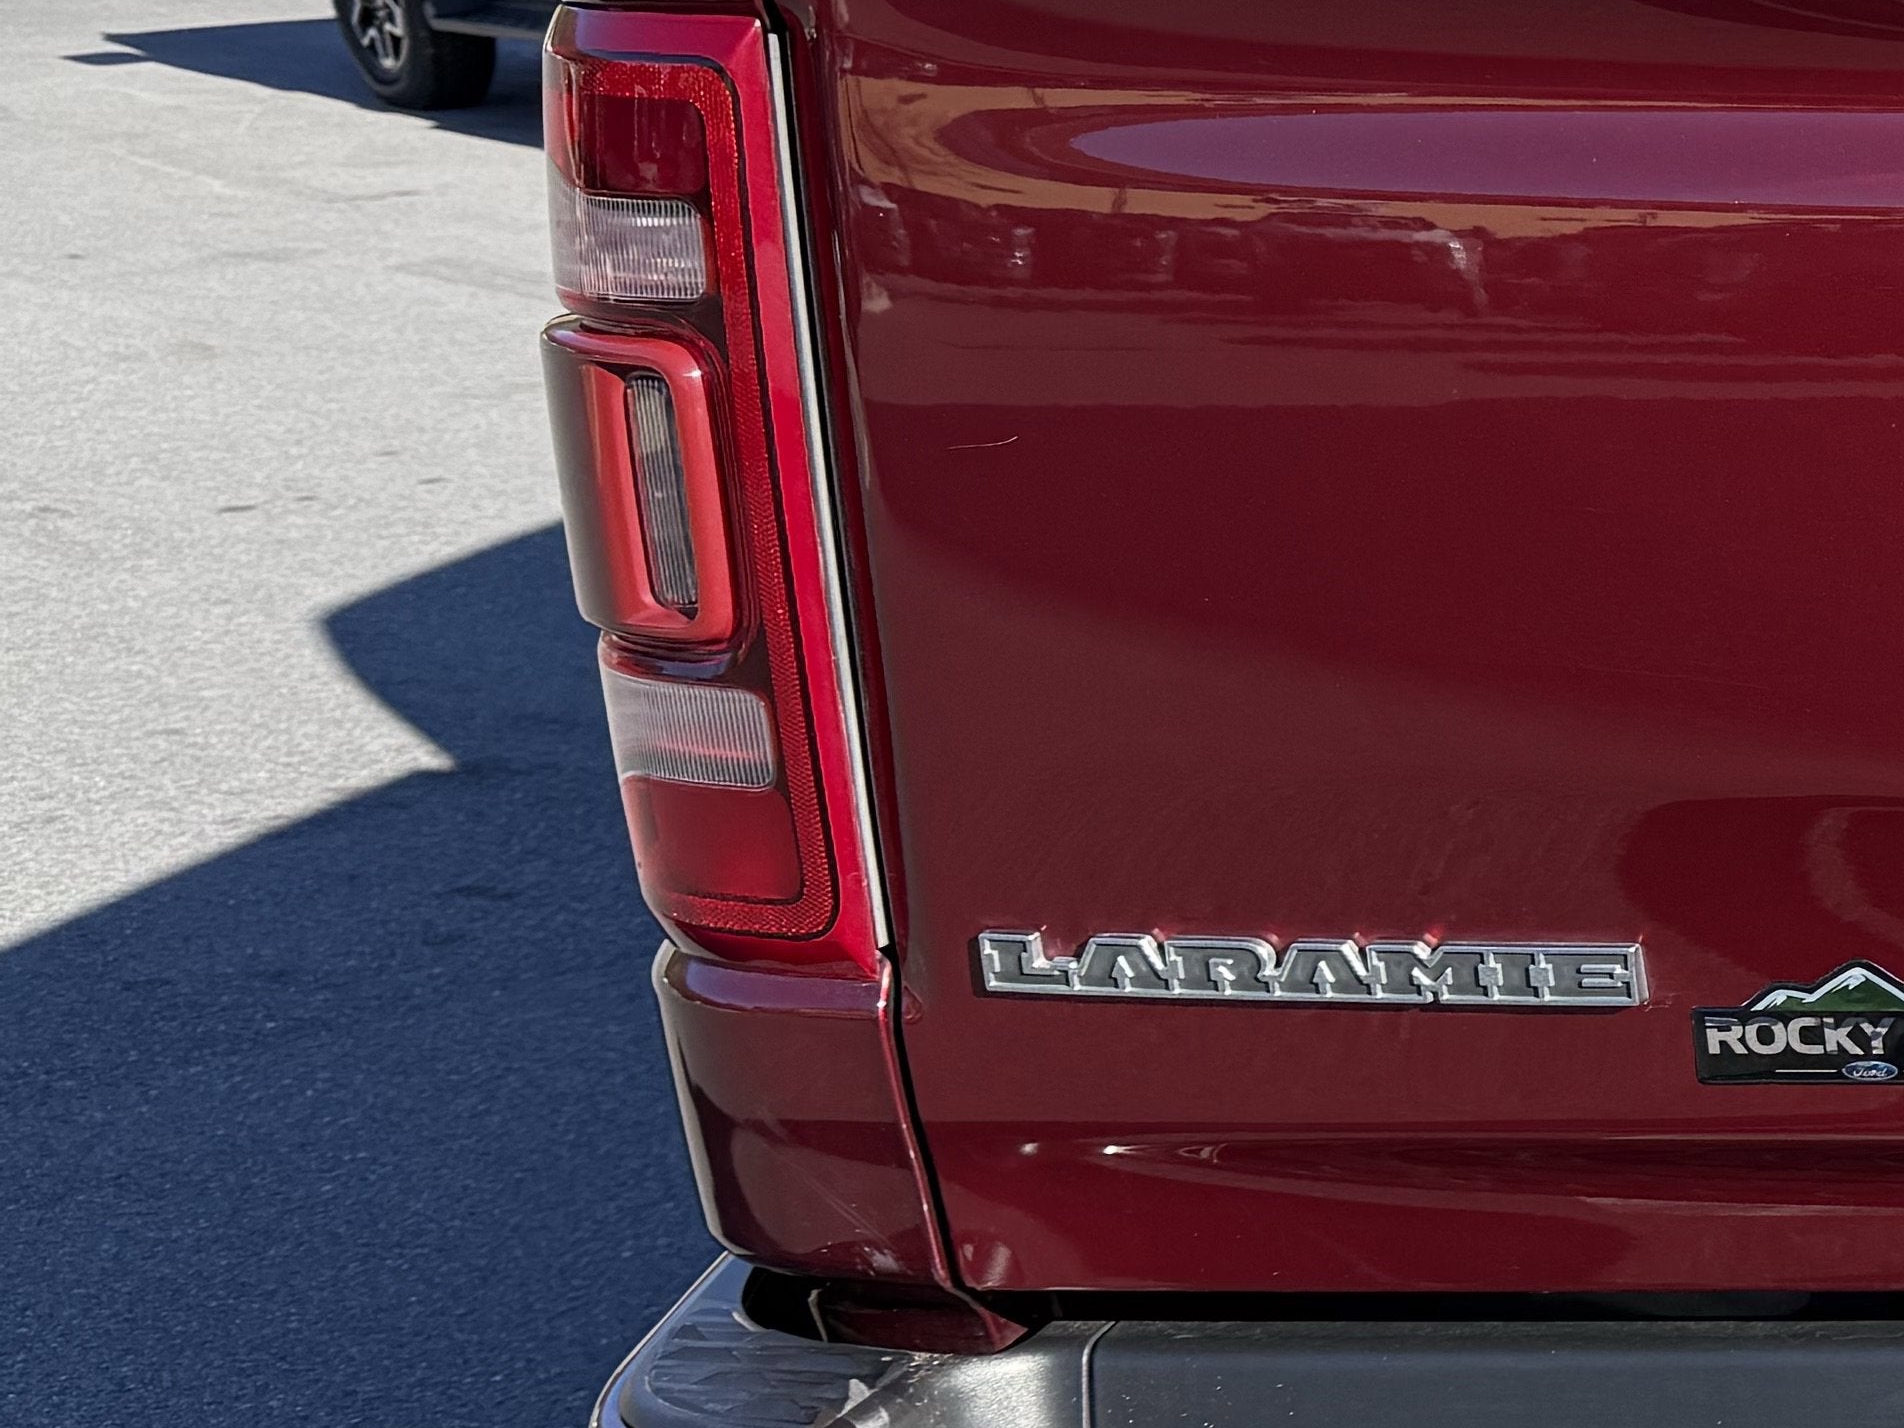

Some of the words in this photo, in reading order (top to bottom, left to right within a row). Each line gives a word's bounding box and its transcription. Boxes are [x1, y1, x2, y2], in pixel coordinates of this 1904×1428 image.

[979, 929, 1649, 1007] LARAMIE
[1704, 1016, 1896, 1056] ROCKY
[1850, 1062, 1889, 1078] Ford
